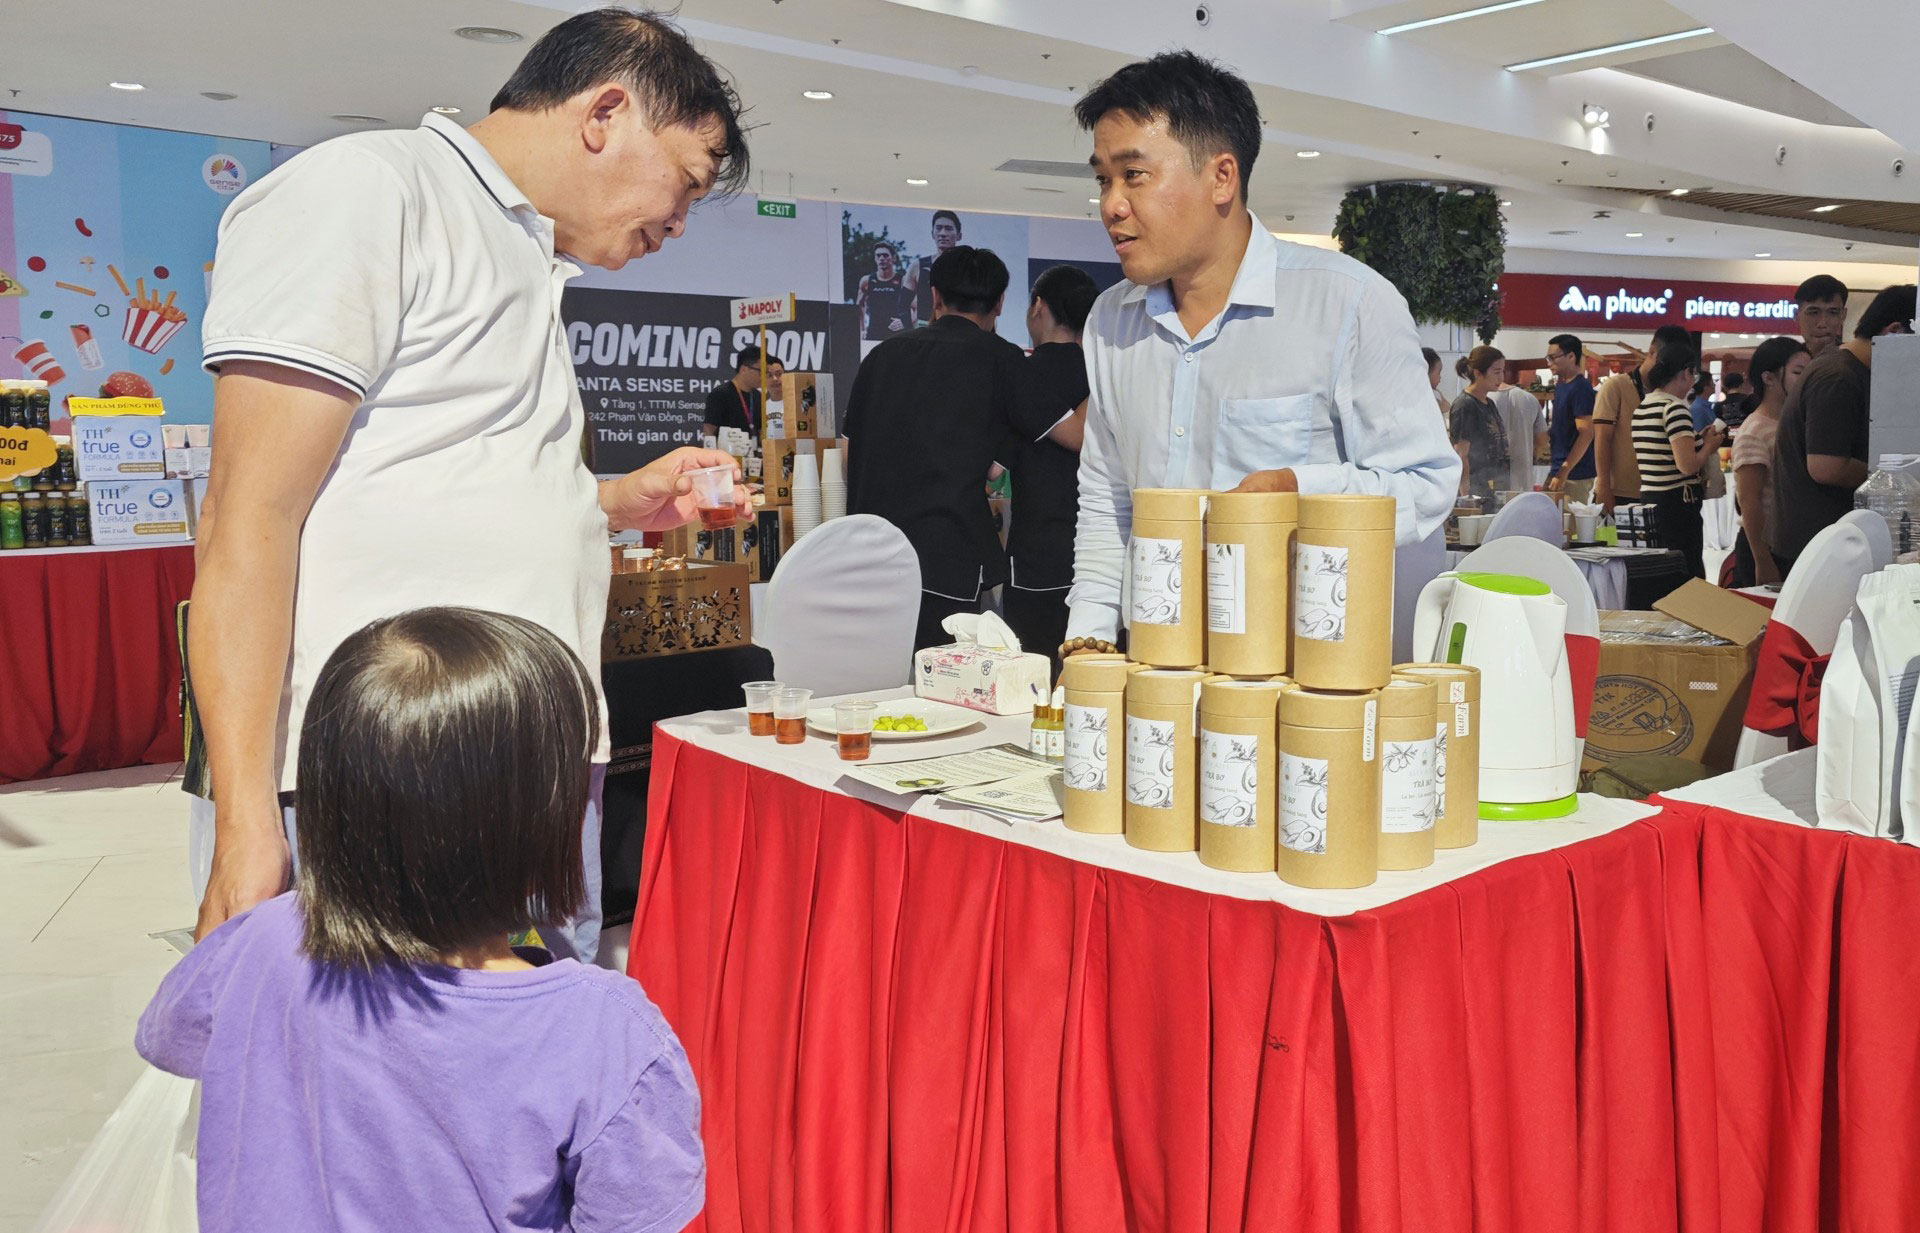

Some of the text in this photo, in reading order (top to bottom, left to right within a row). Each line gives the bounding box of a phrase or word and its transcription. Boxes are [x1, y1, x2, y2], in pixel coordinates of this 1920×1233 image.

[769, 204, 791, 217] EXIT
[1559, 285, 1601, 312] An
[748, 300, 783, 316] NAPOLY
[1686, 296, 1740, 320] pierre
[567, 320, 722, 370] COMING
[626, 377, 684, 393] SENSE
[612, 397, 706, 411] Tầng 1, TTTM Sense
[588, 412, 606, 421] 242
[608, 412, 635, 422] Phạm
[637, 411, 657, 422] Văn
[82, 429, 104, 439] TH
[598, 428, 633, 442] Thời
[637, 429, 668, 444] gian
[673, 429, 693, 444] dự
[82, 440, 120, 454] true
[83, 453, 120, 461] FORMULA
[97, 488, 120, 499] TH
[97, 500, 138, 516] true
[98, 515, 139, 523] FORMULA
